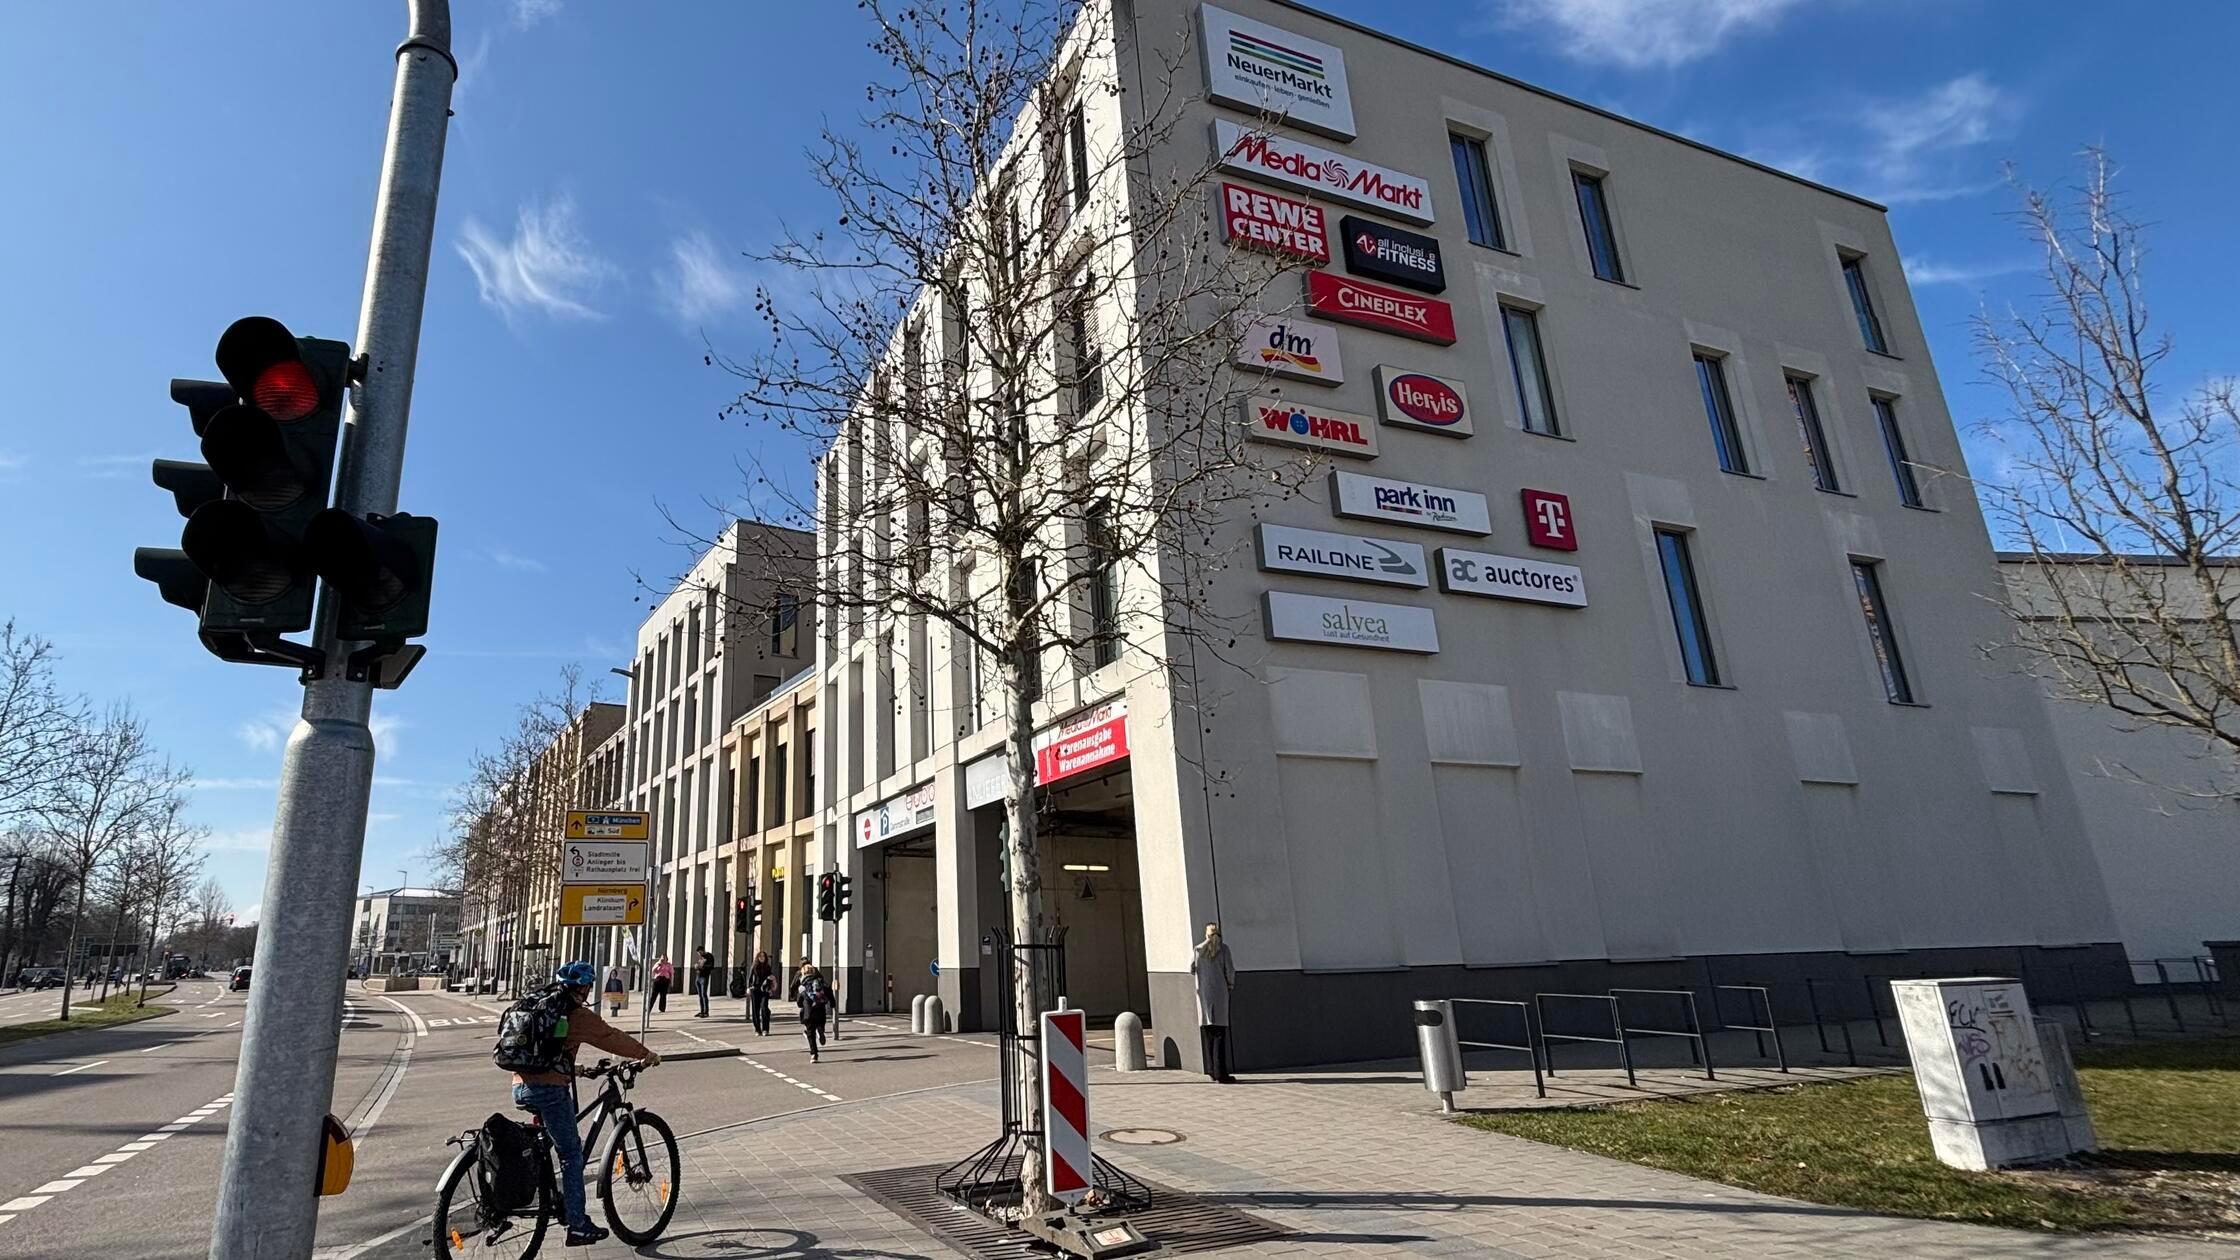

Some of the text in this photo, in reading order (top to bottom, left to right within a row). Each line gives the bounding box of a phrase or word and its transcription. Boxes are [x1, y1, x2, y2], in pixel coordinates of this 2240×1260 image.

[1227, 53, 1332, 99] NeuerMarkt
[1228, 189, 1321, 234] REWE
[1232, 217, 1324, 255] CENTER
[1377, 239, 1389, 248] all
[1377, 248, 1436, 273] FITNESS
[1338, 288, 1427, 324] CINEPLEX
[1270, 325, 1311, 355] dm
[1398, 382, 1458, 414] Hervis
[1258, 406, 1368, 445] WÖHRL
[1374, 487, 1456, 513] park inn
[1536, 499, 1565, 538] T
[1278, 545, 1374, 571] RAILONE
[1322, 605, 1388, 634] salvea
[1059, 728, 1112, 758] Warenausgabe
[428, 1015, 501, 1027] BUS
